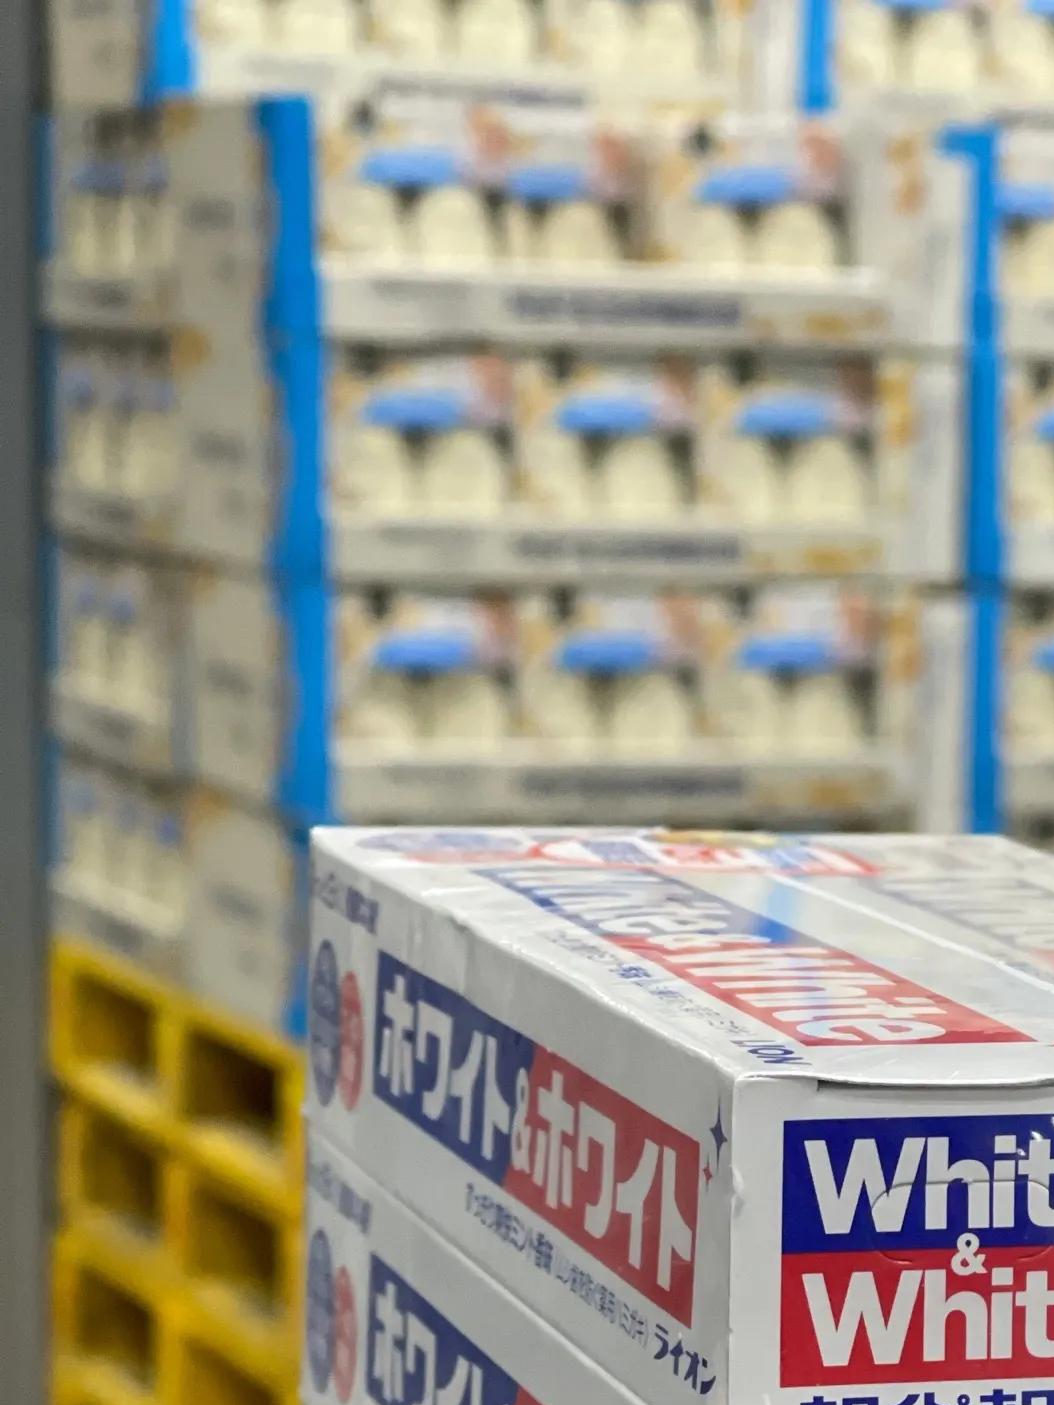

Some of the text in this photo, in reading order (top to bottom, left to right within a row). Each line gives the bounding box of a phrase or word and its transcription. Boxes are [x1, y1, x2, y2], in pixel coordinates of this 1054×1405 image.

[730, 1039, 813, 1066] LION
[379, 973, 692, 1293] ホワイト&ホワイト
[951, 1232, 987, 1276] &
[654, 1323, 716, 1395] ライオン
